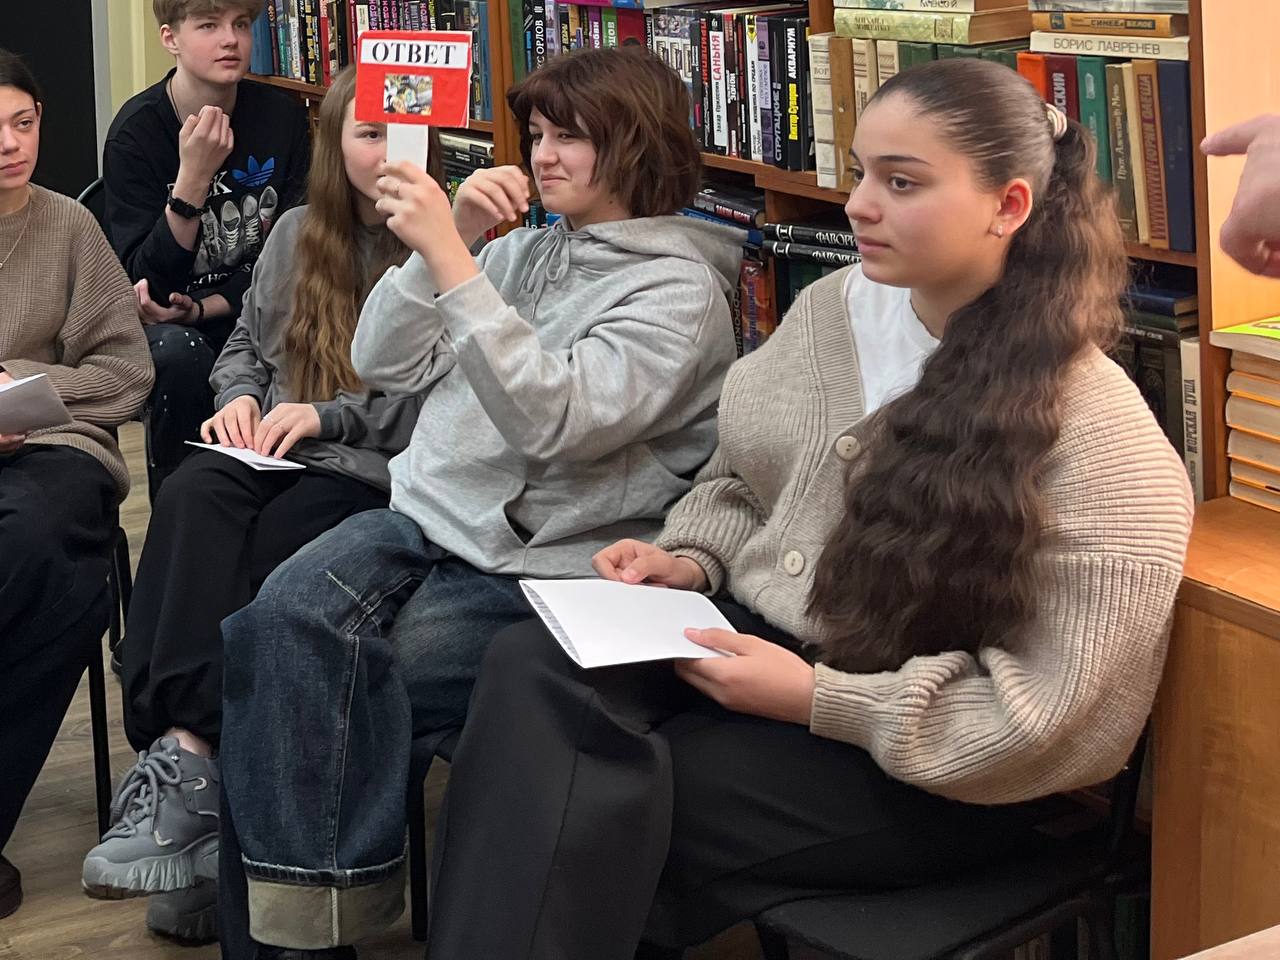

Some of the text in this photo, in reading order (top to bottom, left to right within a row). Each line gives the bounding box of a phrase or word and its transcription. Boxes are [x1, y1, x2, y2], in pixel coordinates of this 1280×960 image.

[372, 42, 456, 65] ОТВЕТ
[535, 19, 545, 55] ОРЛОВ
[788, 27, 797, 79] АКВАРИУМ
[1054, 38, 1160, 55] БОРИС ЛАВРЕНЕВ
[711, 35, 722, 81] САНЬКЯ
[773, 91, 781, 161] СТРУГАЦКИЕ
[1184, 379, 1197, 405] ДУША
[1185, 410, 1198, 454] МОРСКАЯ
